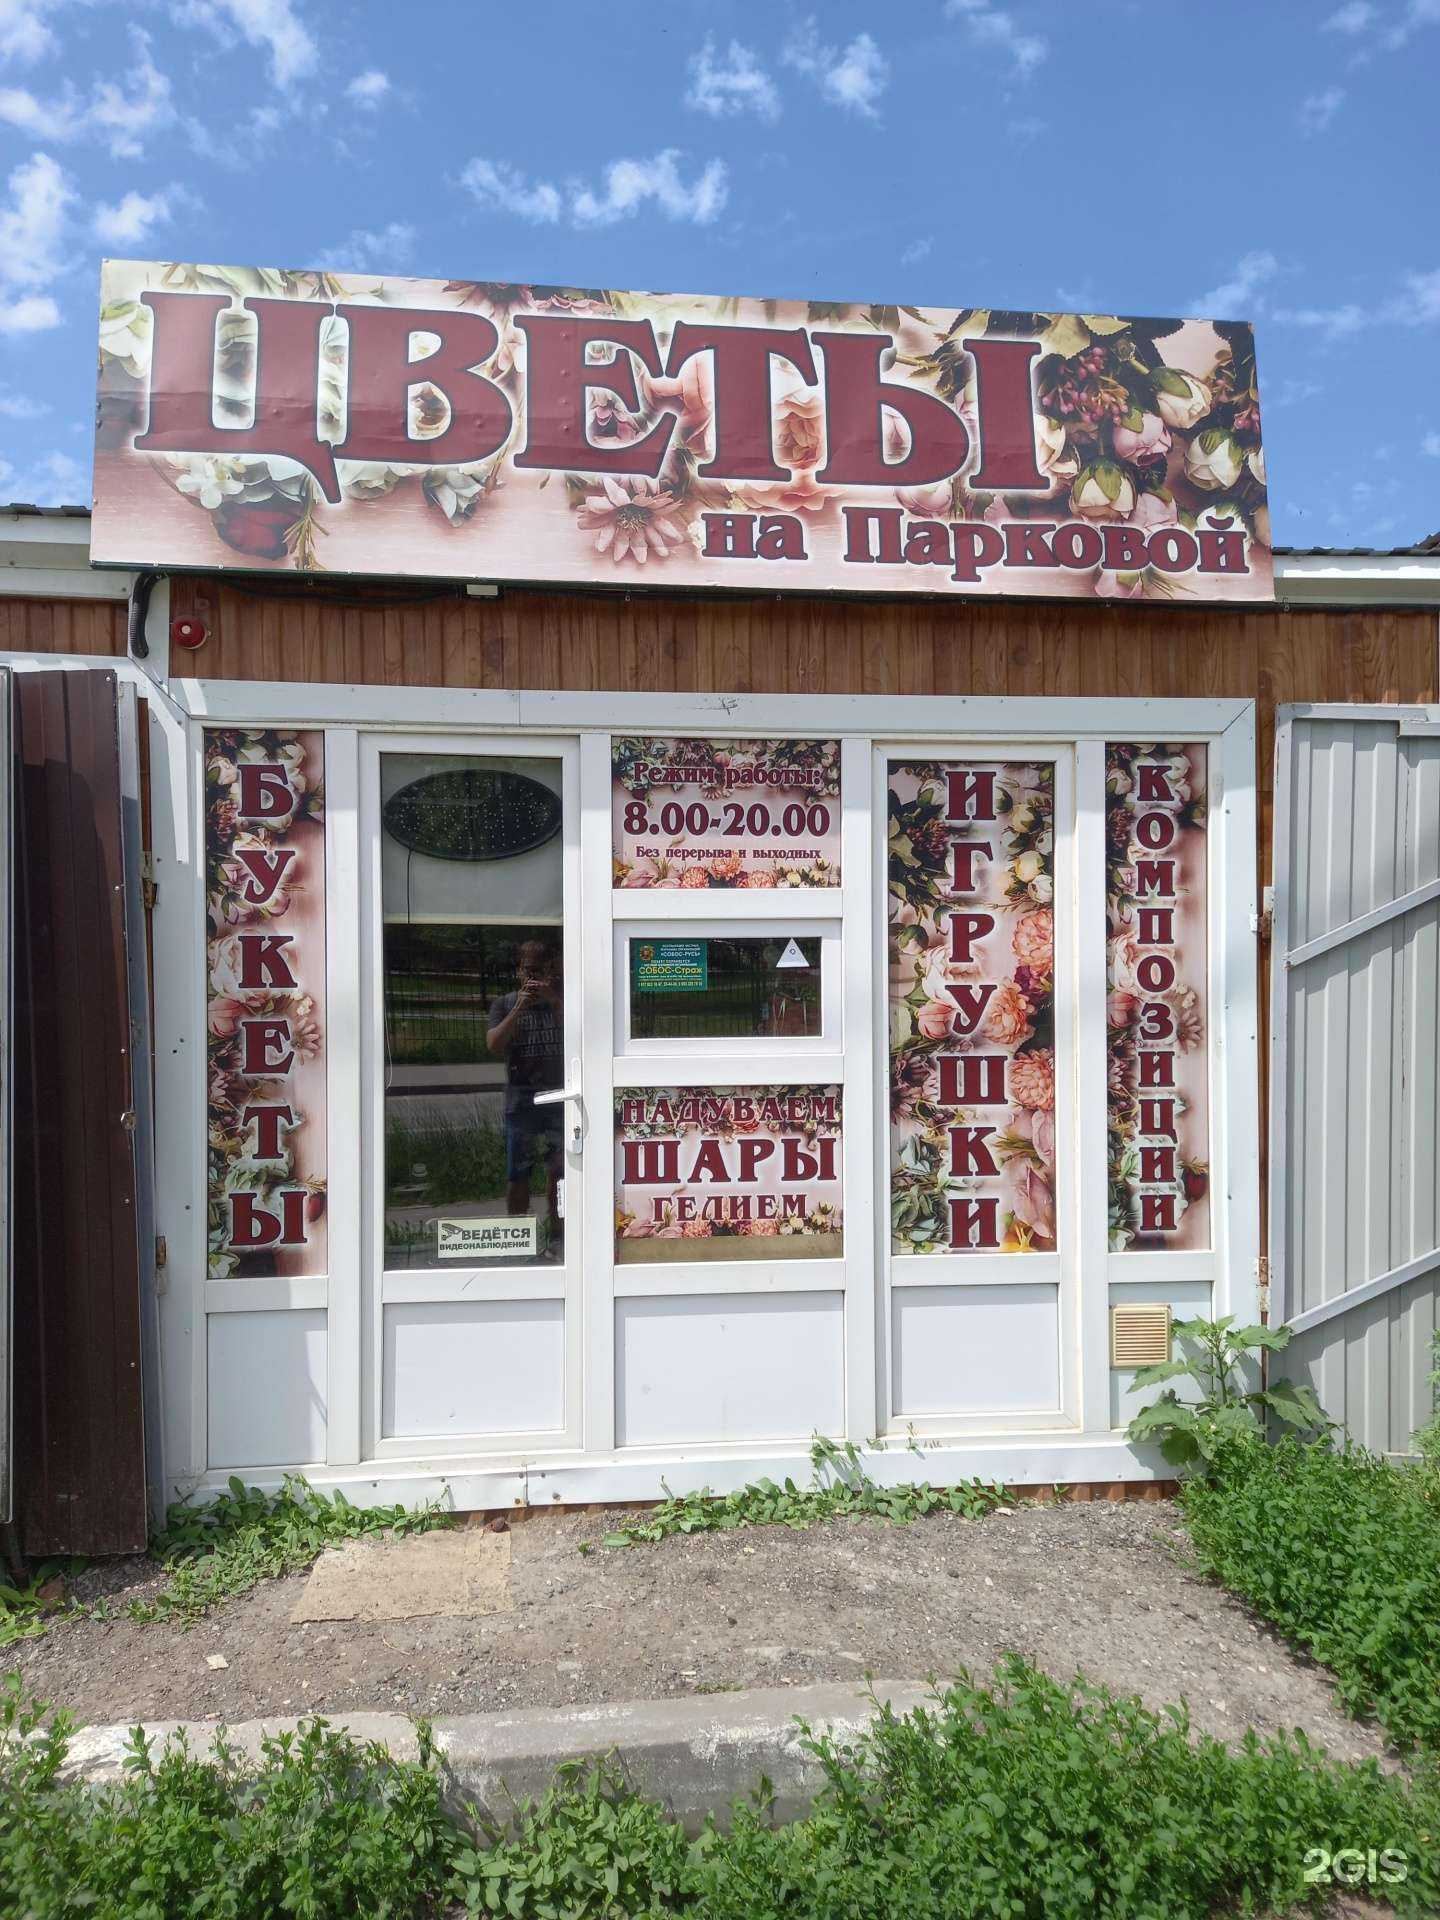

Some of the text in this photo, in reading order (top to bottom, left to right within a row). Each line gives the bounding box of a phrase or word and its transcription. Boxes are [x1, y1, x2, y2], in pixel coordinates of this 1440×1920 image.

[133, 290, 1051, 505] ЦВЕТЫ
[701, 506, 1251, 583] на Парковой
[633, 762, 822, 787] Режим работы:
[623, 801, 831, 837] 8.00-20.00
[635, 846, 822, 861] Без перерыва и выходных
[228, 763, 308, 1247] БУКЕТЫ
[936, 770, 1009, 1249] ИГРУШКИ
[1136, 764, 1178, 1232] КОМПОЗИЦИИ
[622, 1096, 836, 1127] НАДУВАЕМ
[621, 1137, 838, 1185] ШАРЫ
[652, 1194, 808, 1222] ГЕЛИЕМ
[439, 1240, 531, 1251] ВИДЕОНАБЛЮДЕНИЕ
[461, 1227, 531, 1242] ВЕДЁТСЯ
